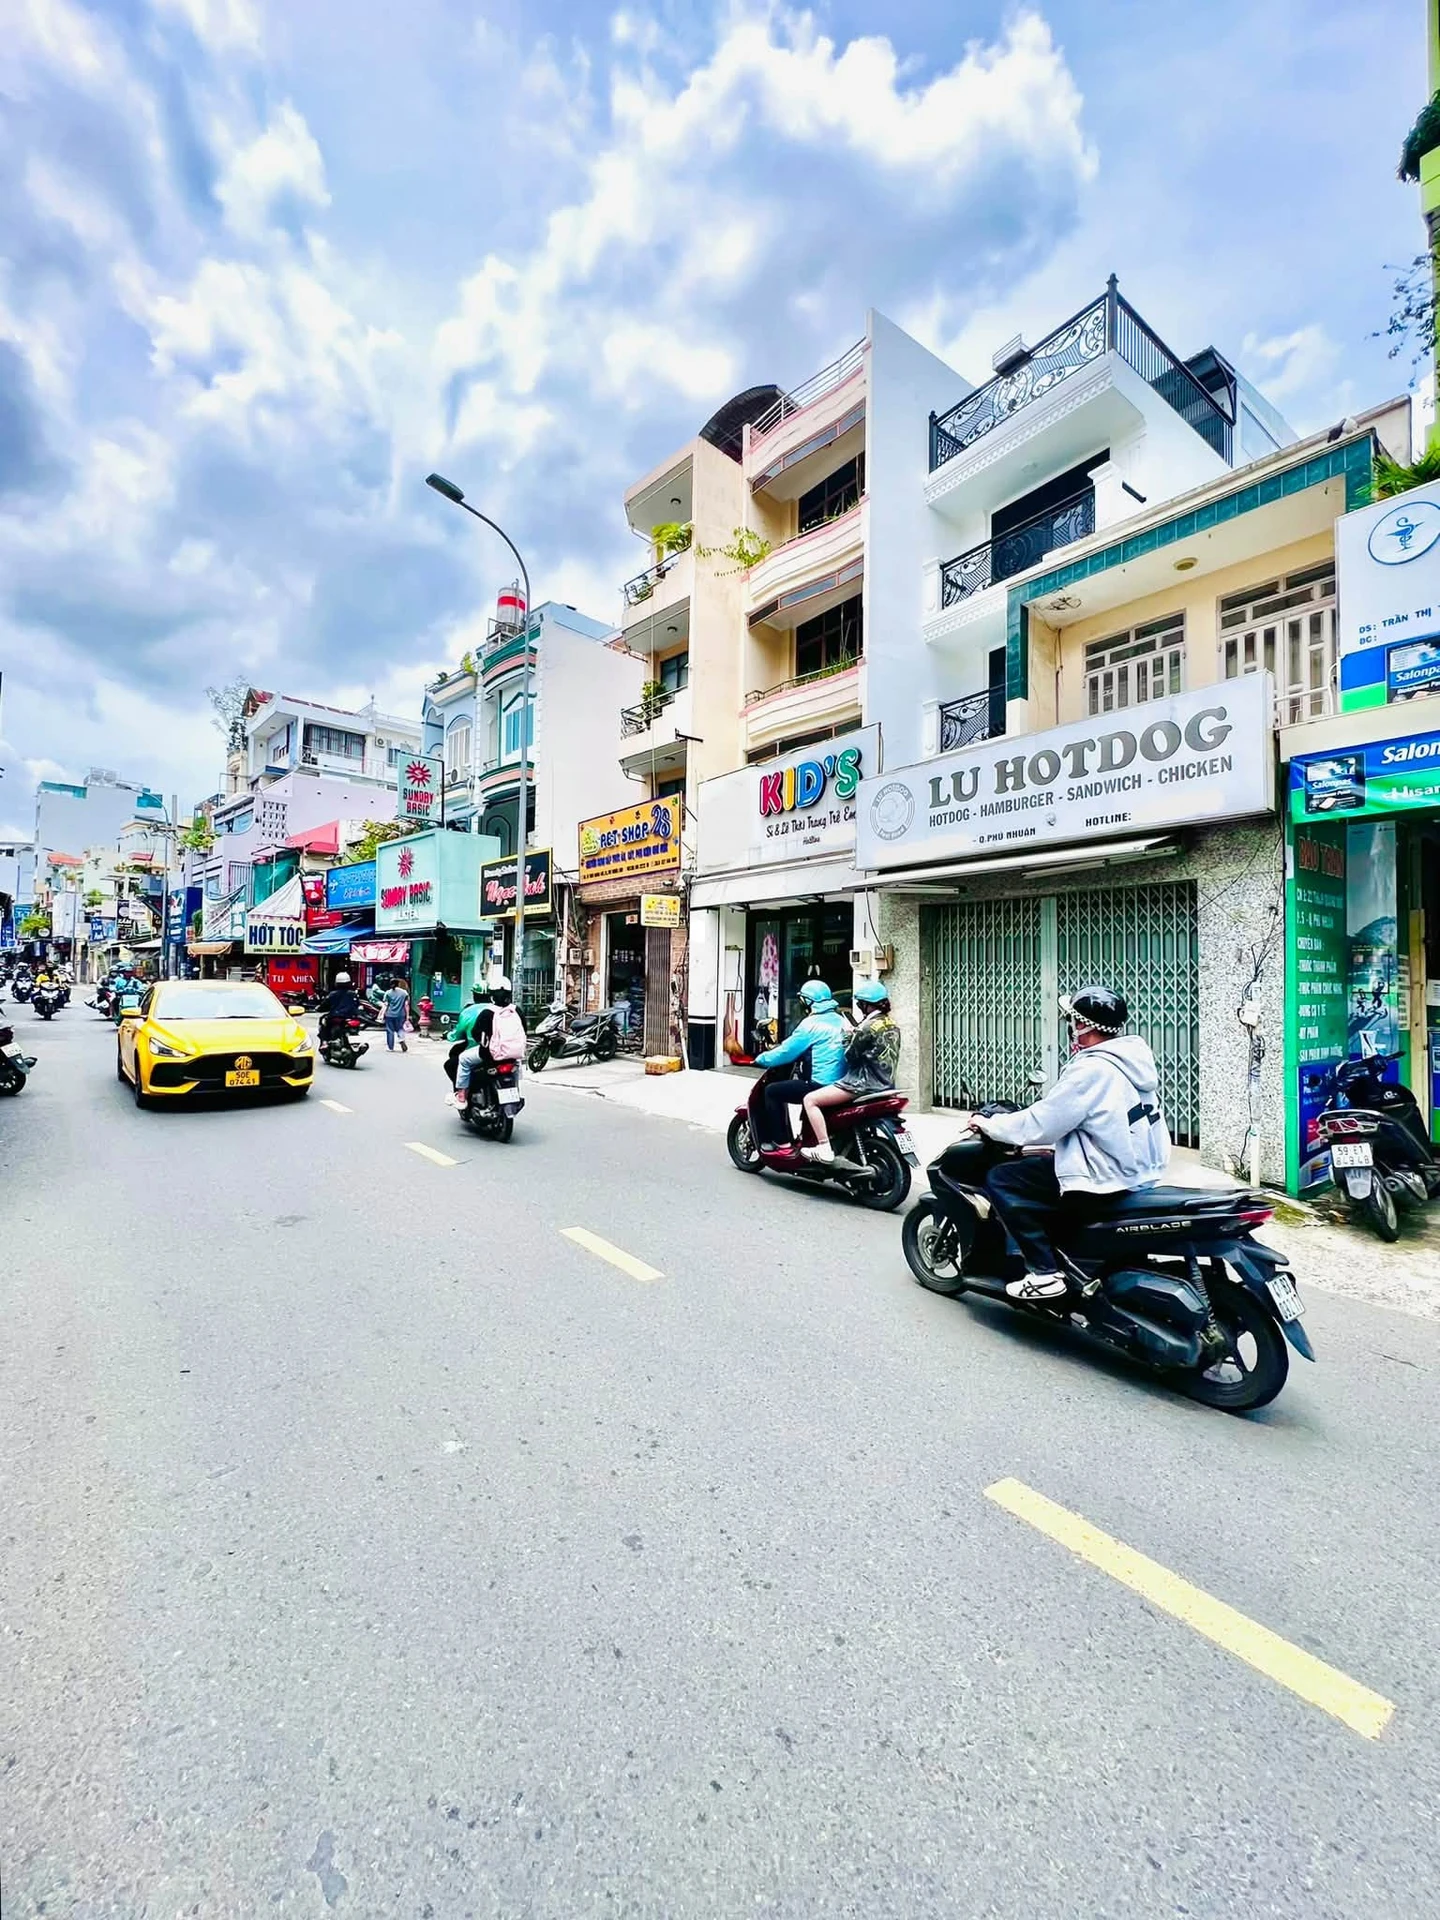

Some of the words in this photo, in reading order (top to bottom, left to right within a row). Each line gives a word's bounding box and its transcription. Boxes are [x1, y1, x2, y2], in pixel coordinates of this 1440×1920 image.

[928, 766, 981, 809] LU
[993, 706, 1233, 795] HOTDOG
[760, 747, 862, 818] KID'S
[929, 808, 970, 828] HOTDOG
[980, 792, 1054, 818] HAMBURGER
[1066, 773, 1142, 802] SANDWICH
[1157, 754, 1233, 785] CHICKEN
[403, 787, 434, 805] SUNDAY
[406, 801, 430, 816] BASIC
[1085, 811, 1132, 828] HOTLINE:
[600, 829, 618, 848] PET
[621, 821, 649, 843] SHOP
[380, 884, 407, 910] SUNDAY
[409, 881, 431, 905] BASIC
[248, 921, 275, 946] HỚT
[278, 923, 304, 946] TÓC
[1115, 1220, 1192, 1233] AIRBLADE
